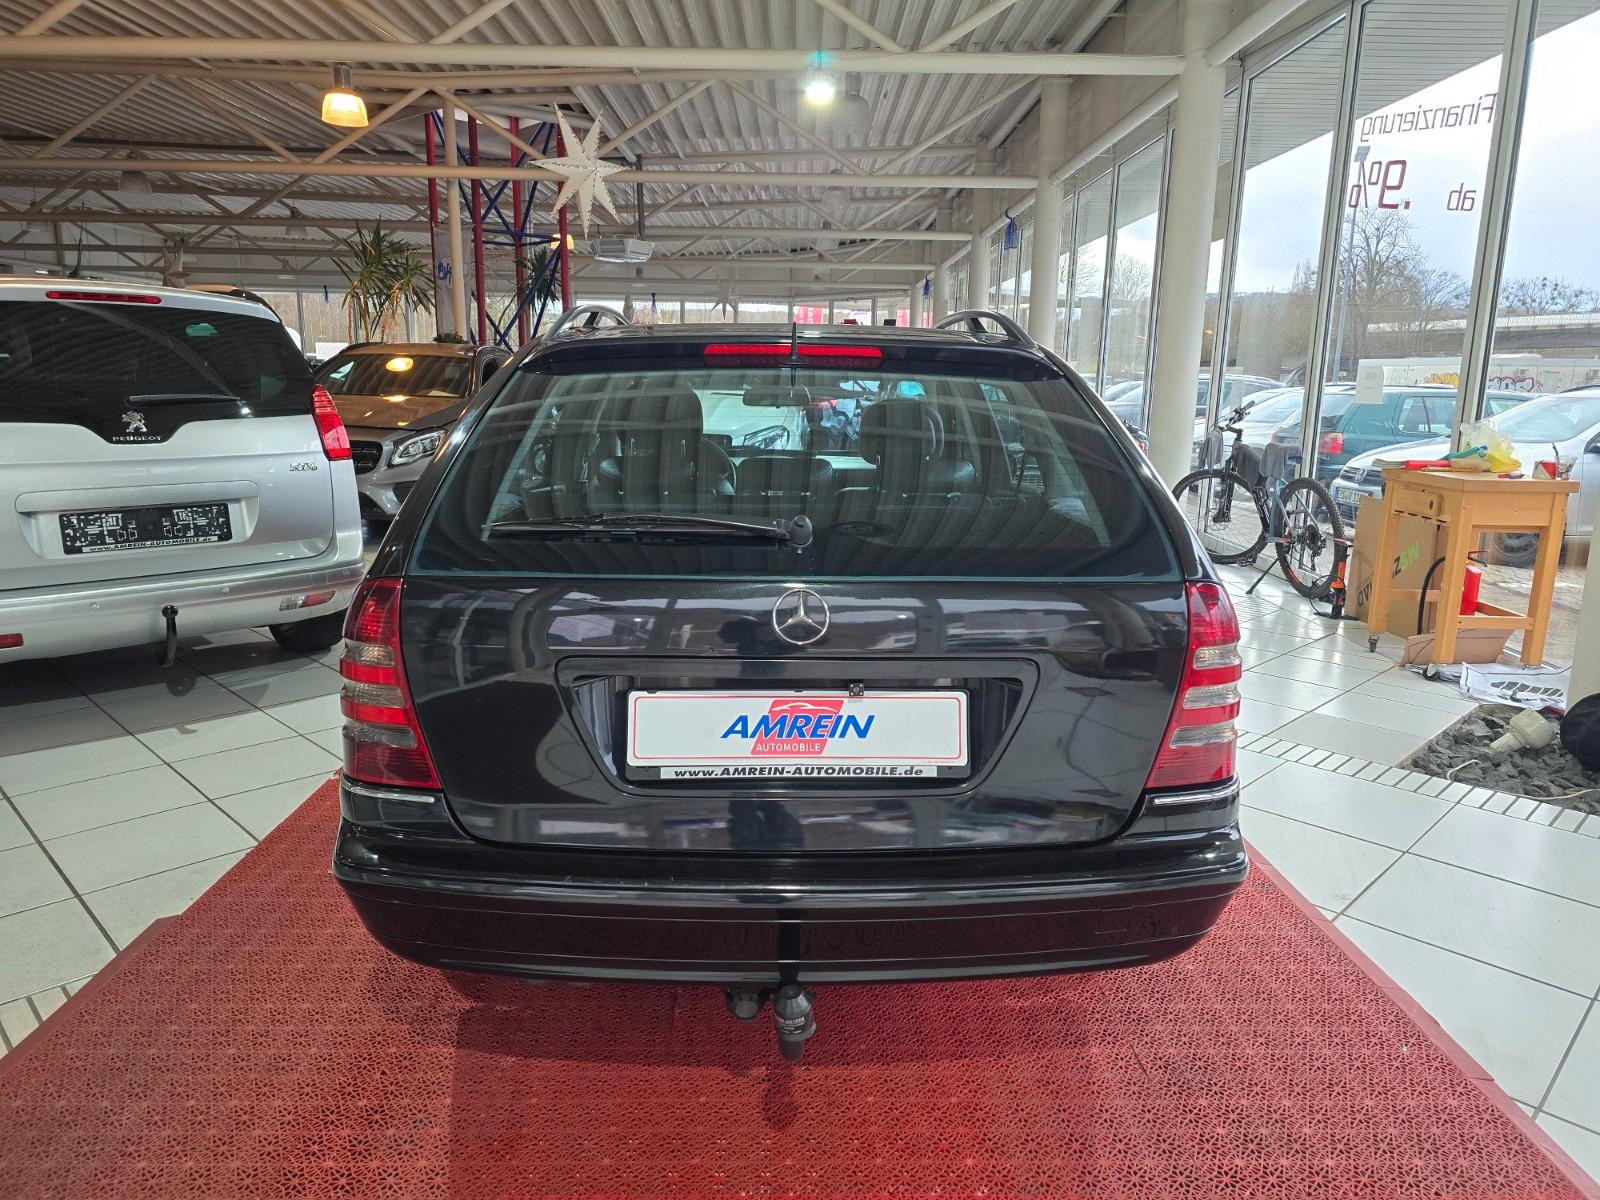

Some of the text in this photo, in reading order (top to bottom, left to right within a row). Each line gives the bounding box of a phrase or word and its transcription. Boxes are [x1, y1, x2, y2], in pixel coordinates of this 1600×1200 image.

[720, 714, 876, 740] AMREIN
[756, 743, 821, 752] AUTOMOBILE
[674, 765, 924, 777] www.AMREIN-AUTOMOBILE.de
